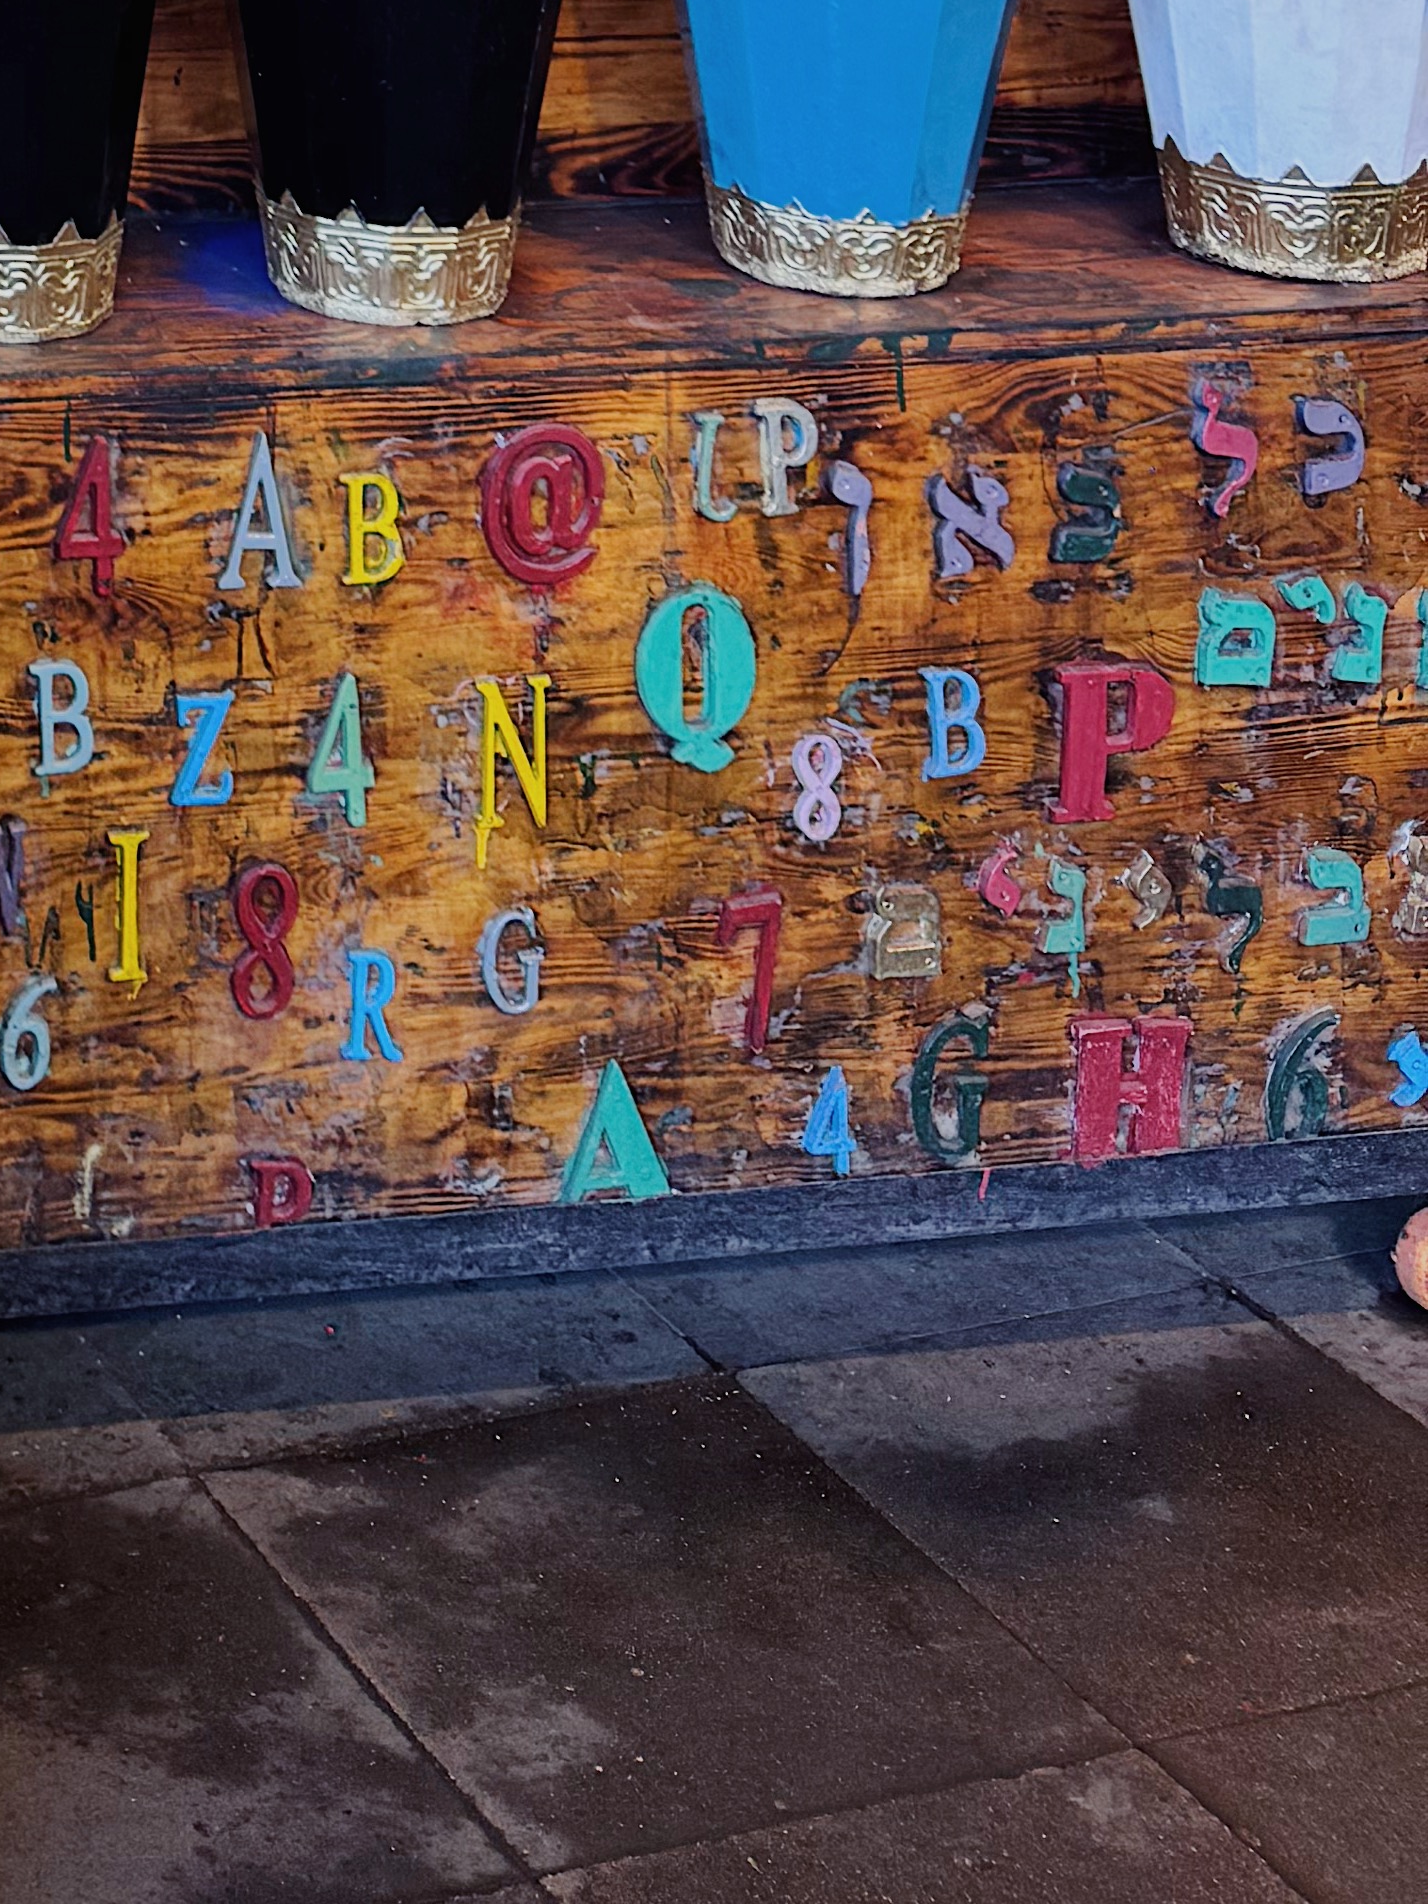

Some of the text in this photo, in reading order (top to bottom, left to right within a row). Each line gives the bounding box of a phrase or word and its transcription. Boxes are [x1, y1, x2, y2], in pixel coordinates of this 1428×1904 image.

[52, 434, 127, 596] 4
[218, 430, 302, 589] A
[338, 472, 406, 586] B
[28, 658, 94, 776] B
[169, 688, 236, 807] Z
[306, 672, 376, 828] 4
[474, 672, 551, 829] N
[633, 580, 757, 773] Q
[791, 734, 843, 841] 8
[917, 665, 986, 782] B
[1052, 660, 1176, 822] P
[230, 862, 299, 1020] 8
[340, 948, 404, 1063] R
[476, 906, 545, 1015] G
[559, 1058, 671, 1202] A
[802, 1064, 857, 1176] 4
[910, 1006, 990, 1160] G
[1069, 1014, 1194, 1170] H
